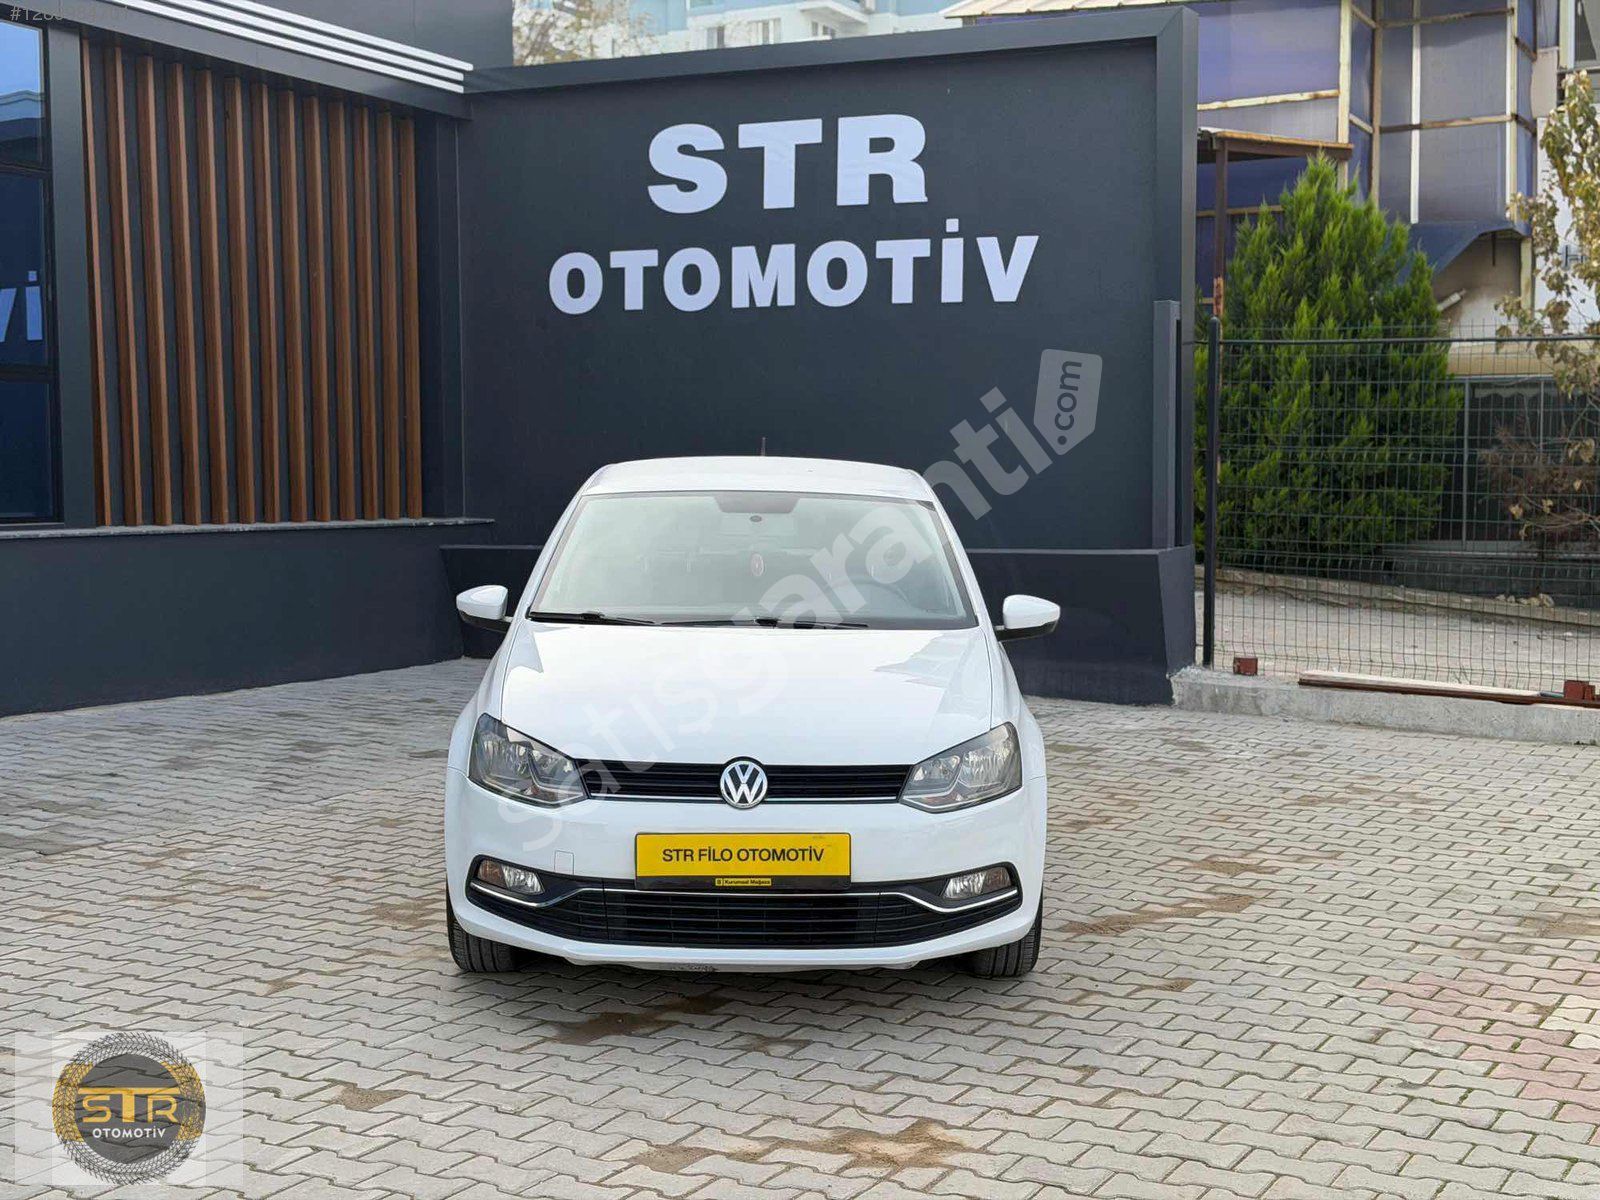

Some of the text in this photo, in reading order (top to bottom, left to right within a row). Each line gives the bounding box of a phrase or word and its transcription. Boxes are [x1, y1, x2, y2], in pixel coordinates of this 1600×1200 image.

[647, 114, 928, 214] STR
[549, 218, 1040, 315] OTOMOTİV
[661, 845, 825, 863] STR FİLO OTOMOTİV
